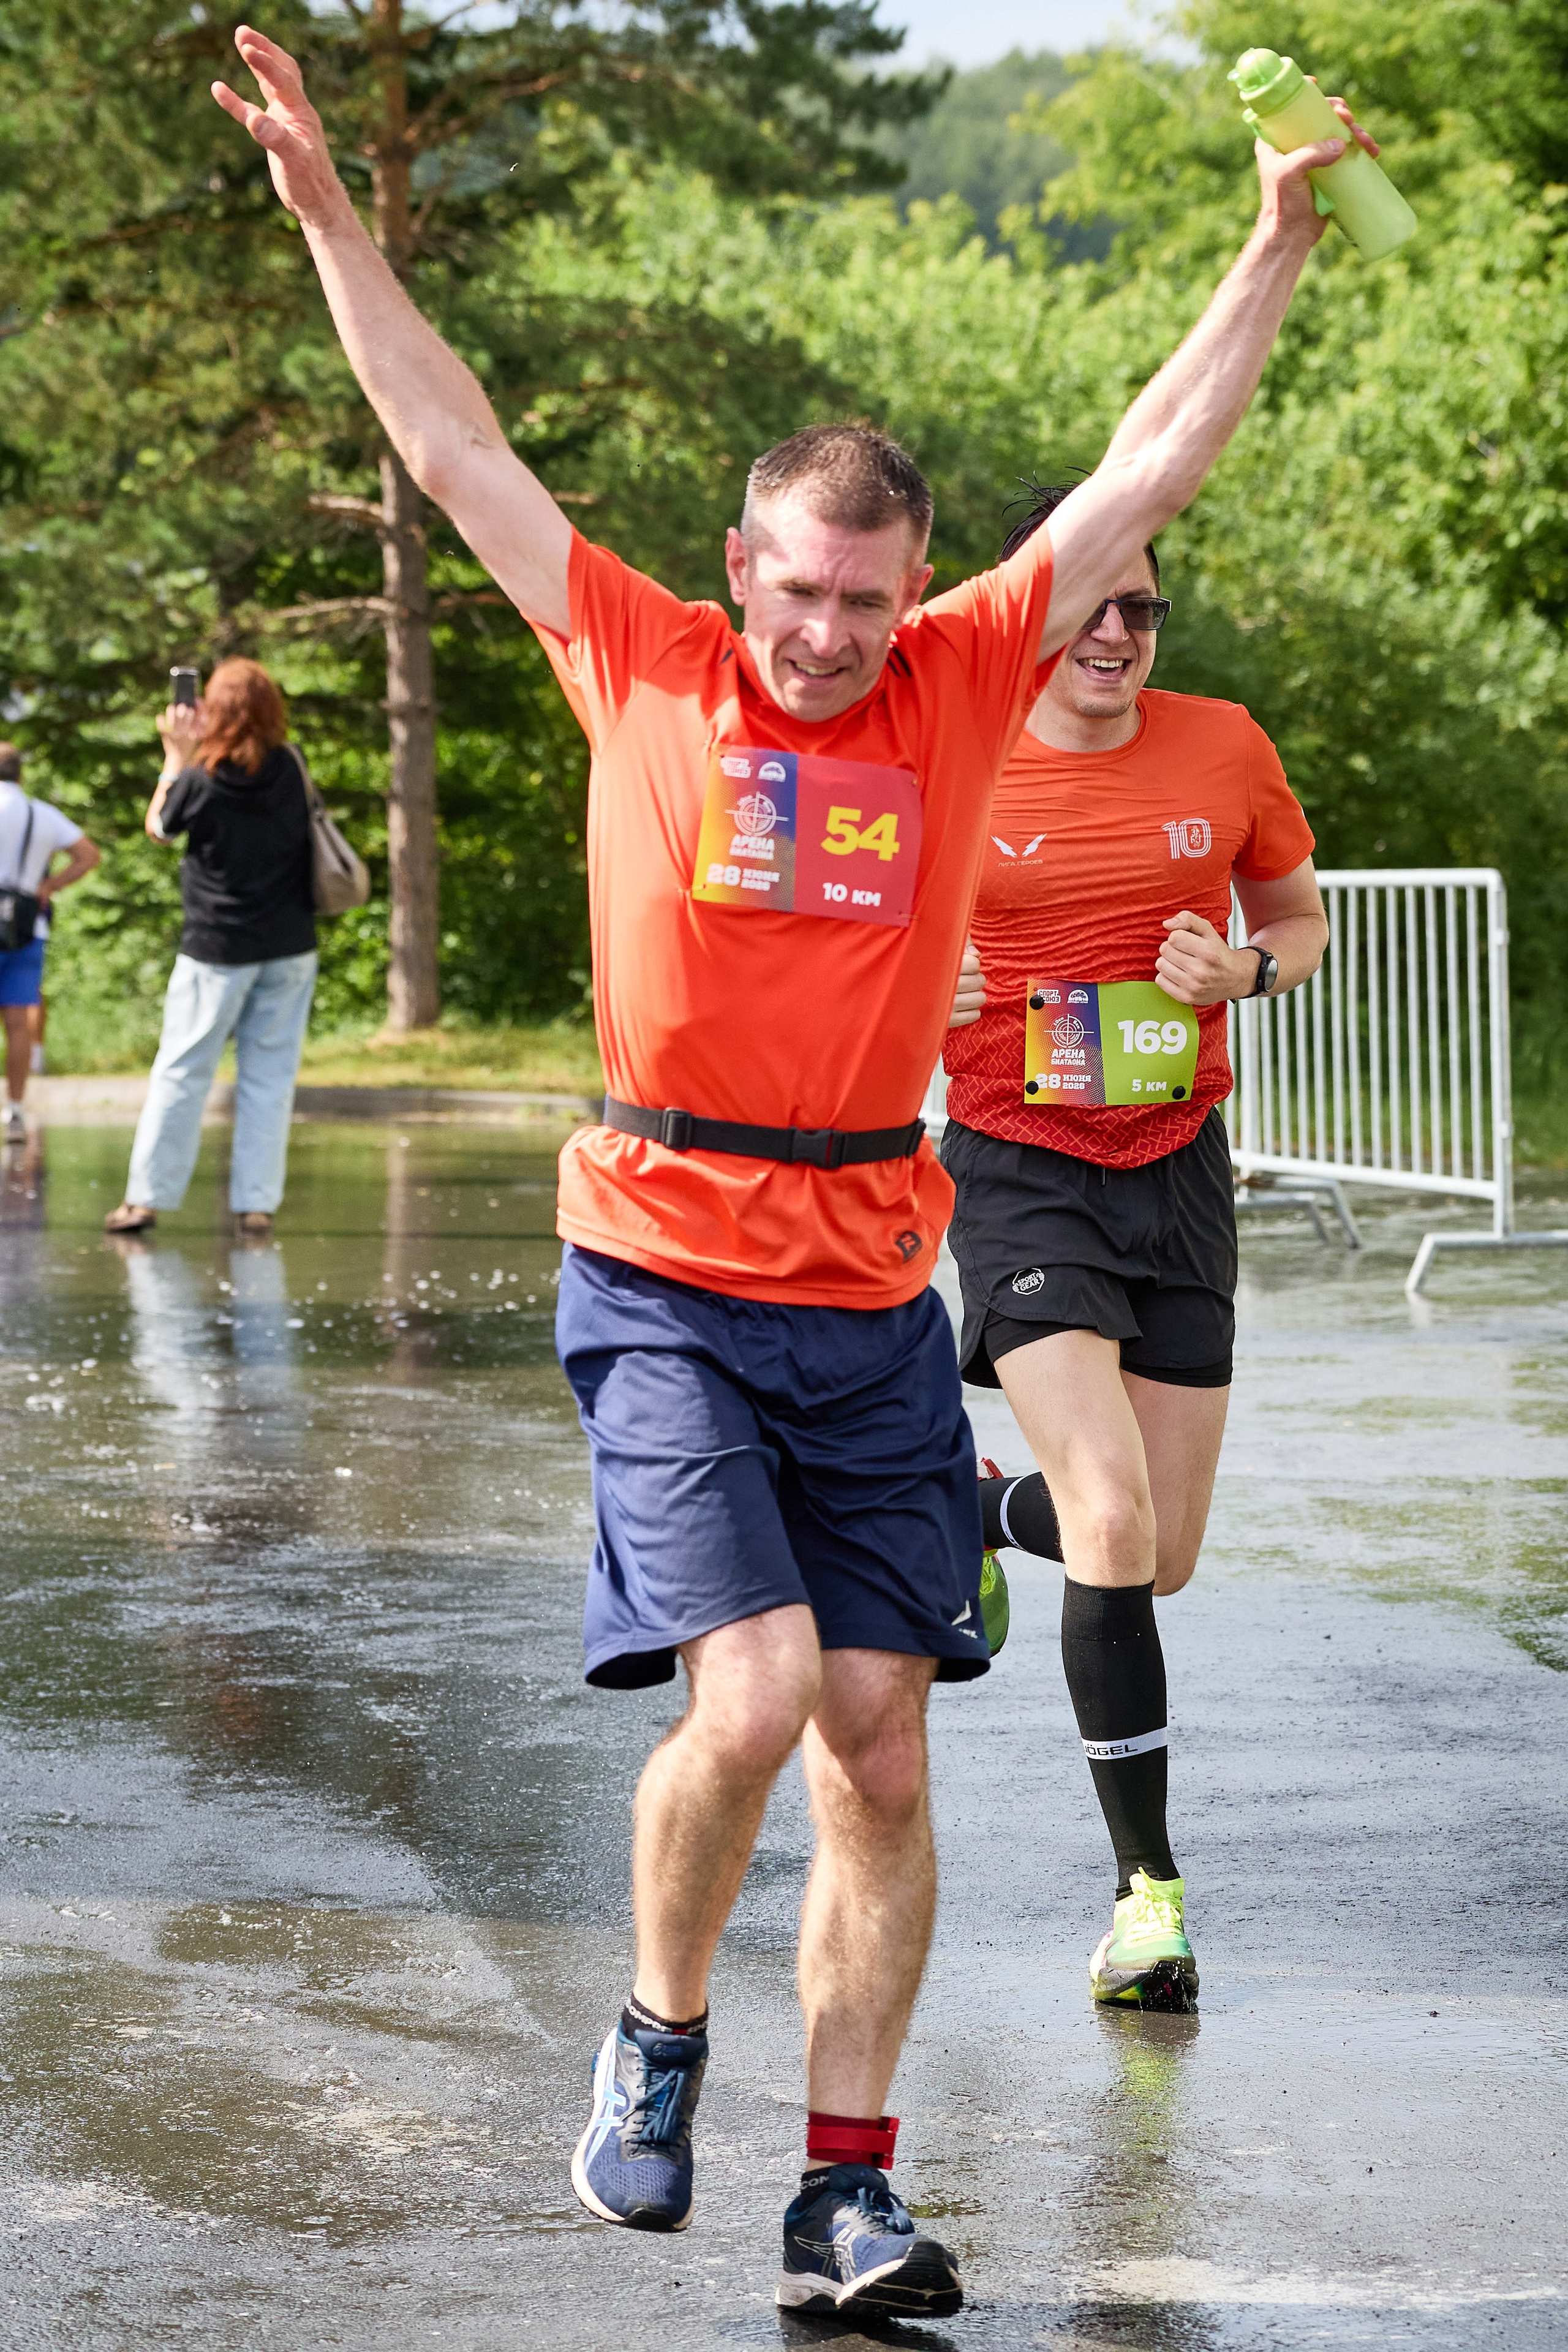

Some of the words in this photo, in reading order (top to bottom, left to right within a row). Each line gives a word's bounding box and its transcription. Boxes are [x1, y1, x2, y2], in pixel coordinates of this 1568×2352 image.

[820, 805, 900, 861] 54
[1161, 818, 1212, 859] 10
[706, 863, 741, 886] 28
[823, 883, 847, 902] 10
[1117, 1020, 1187, 1054] 169
[1051, 1048, 1085, 1058] АРЕНА
[1035, 1073, 1061, 1088] 28
[1131, 1079, 1142, 1091] 5
[1017, 1273, 1036, 1285] SPORT
[1020, 1279, 1040, 1291] GEAR
